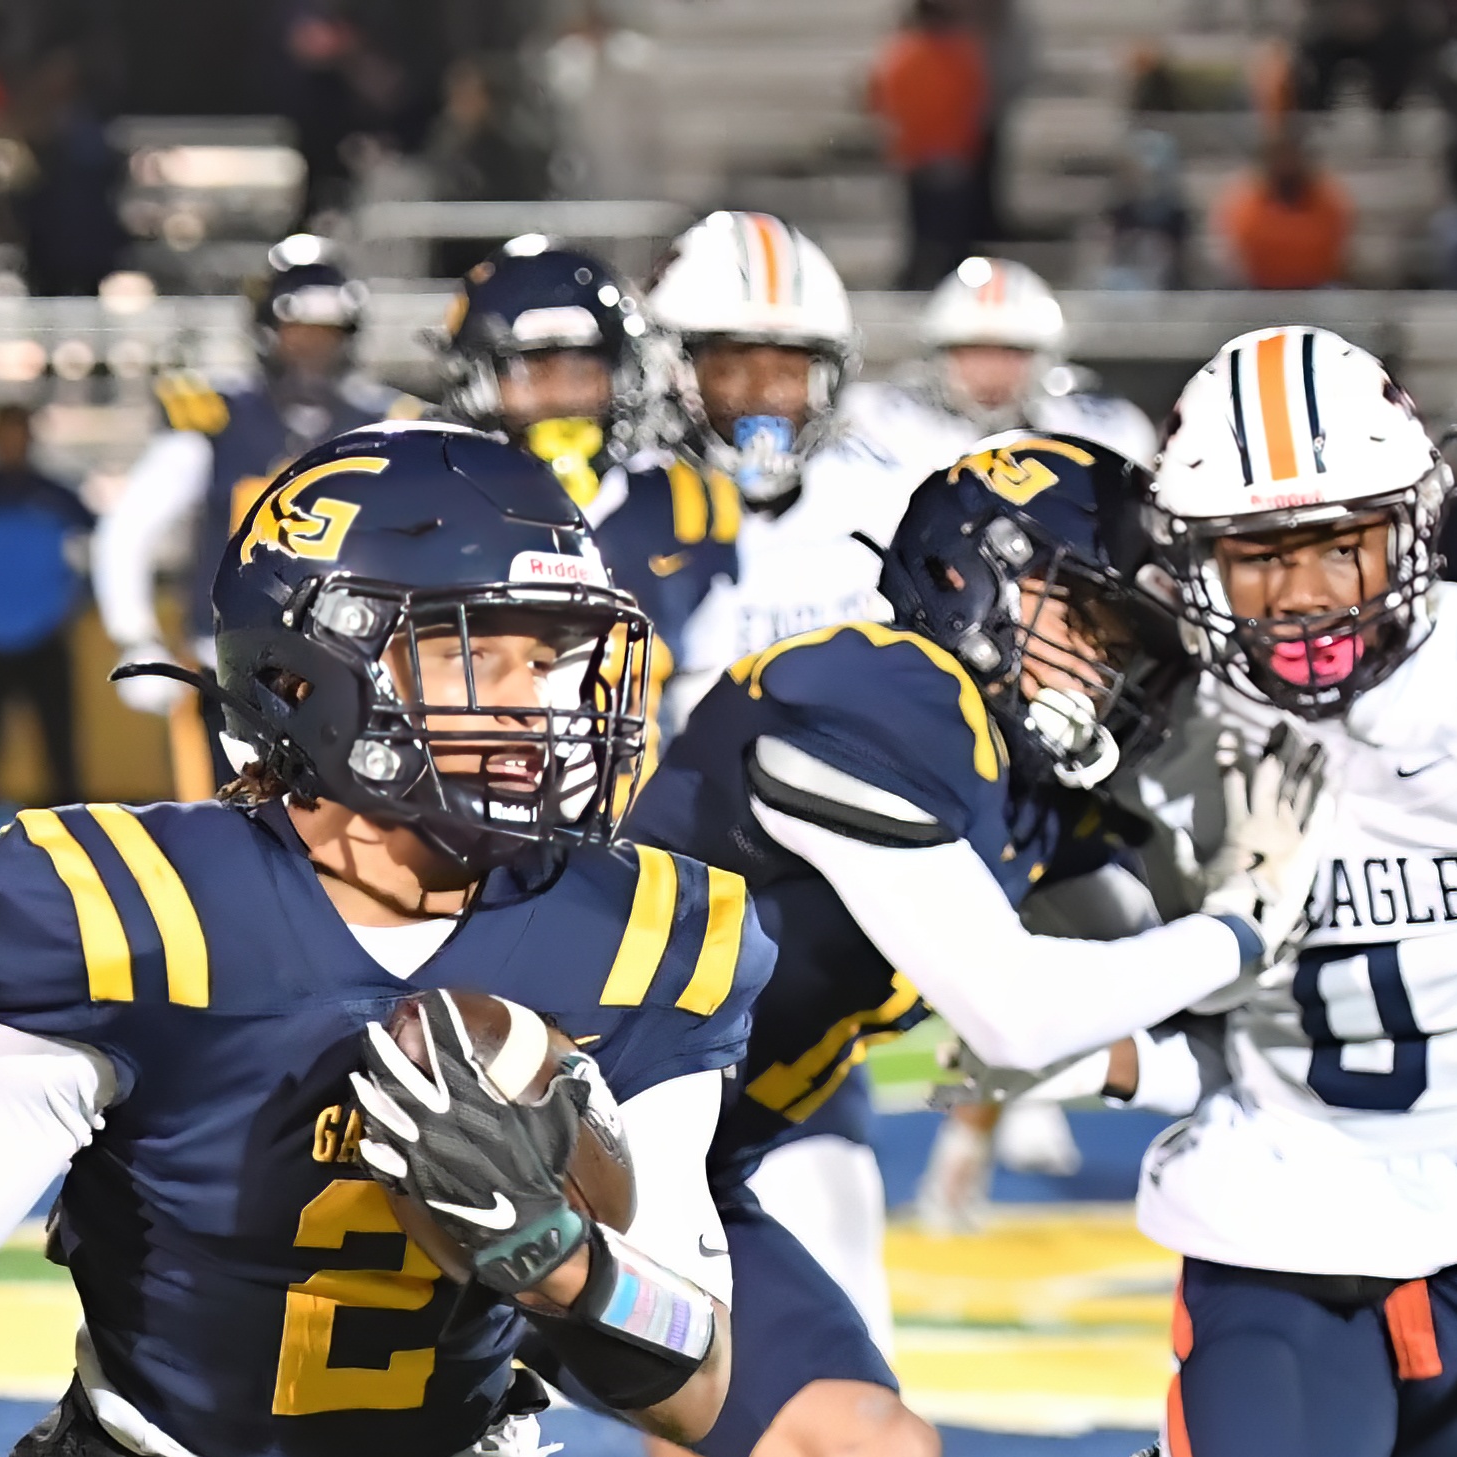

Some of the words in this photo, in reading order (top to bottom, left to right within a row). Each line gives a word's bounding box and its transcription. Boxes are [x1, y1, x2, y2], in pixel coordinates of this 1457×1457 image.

[529, 558, 593, 581] Ridde
[1293, 941, 1427, 1113] 0
[311, 1104, 363, 1164] GA
[271, 1179, 442, 1416] 2
